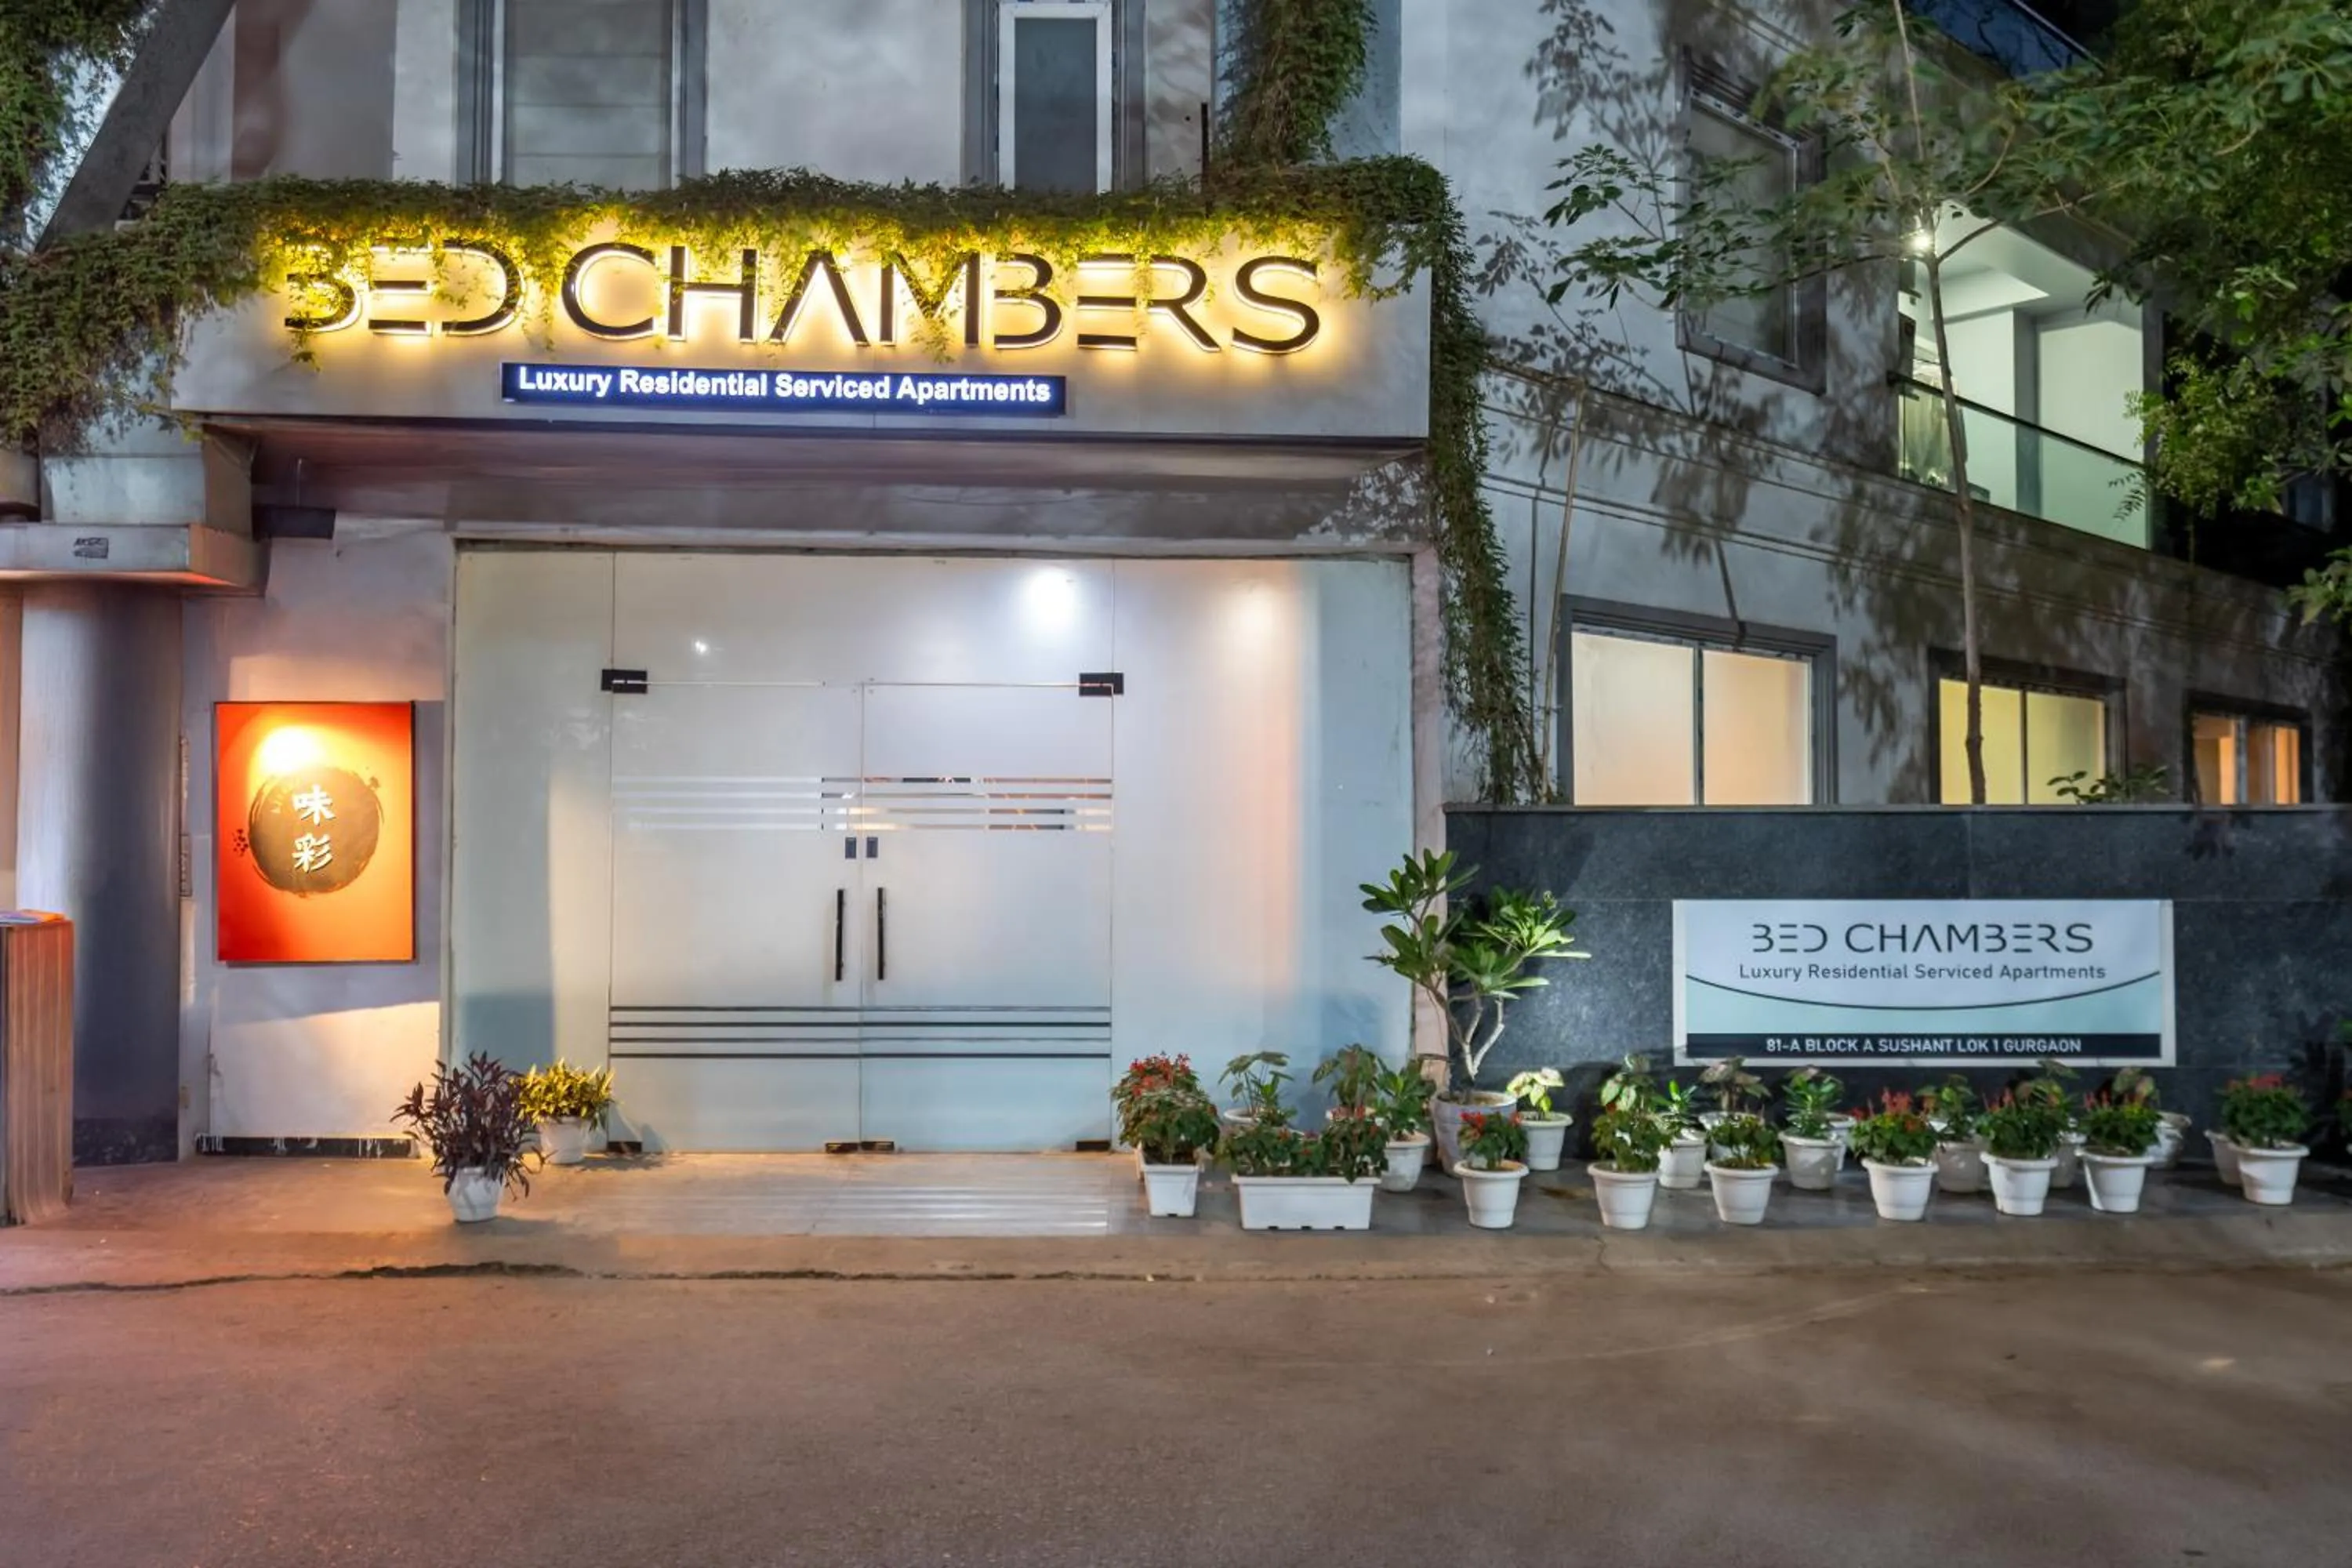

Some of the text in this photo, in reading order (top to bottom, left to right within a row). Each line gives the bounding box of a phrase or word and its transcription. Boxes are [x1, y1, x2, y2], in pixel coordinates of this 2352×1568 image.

[561, 241, 1321, 353] CHAMBERS
[519, 365, 1052, 405] Luxury Residential Serviced Apartments
[292, 784, 336, 873] 味彩
[1752, 923, 2094, 953] BED CHAMBERS
[1739, 964, 2107, 982] Luxury Residential Serviced Apartments
[1766, 1038, 1802, 1052] 81-A
[1805, 1038, 1859, 1052] BLOCK
[1862, 1038, 1875, 1052] A
[1878, 1038, 1954, 1053] SUSHANT
[1957, 1039, 1987, 1053] LOK
[2002, 1039, 2082, 1053] GURGAON
